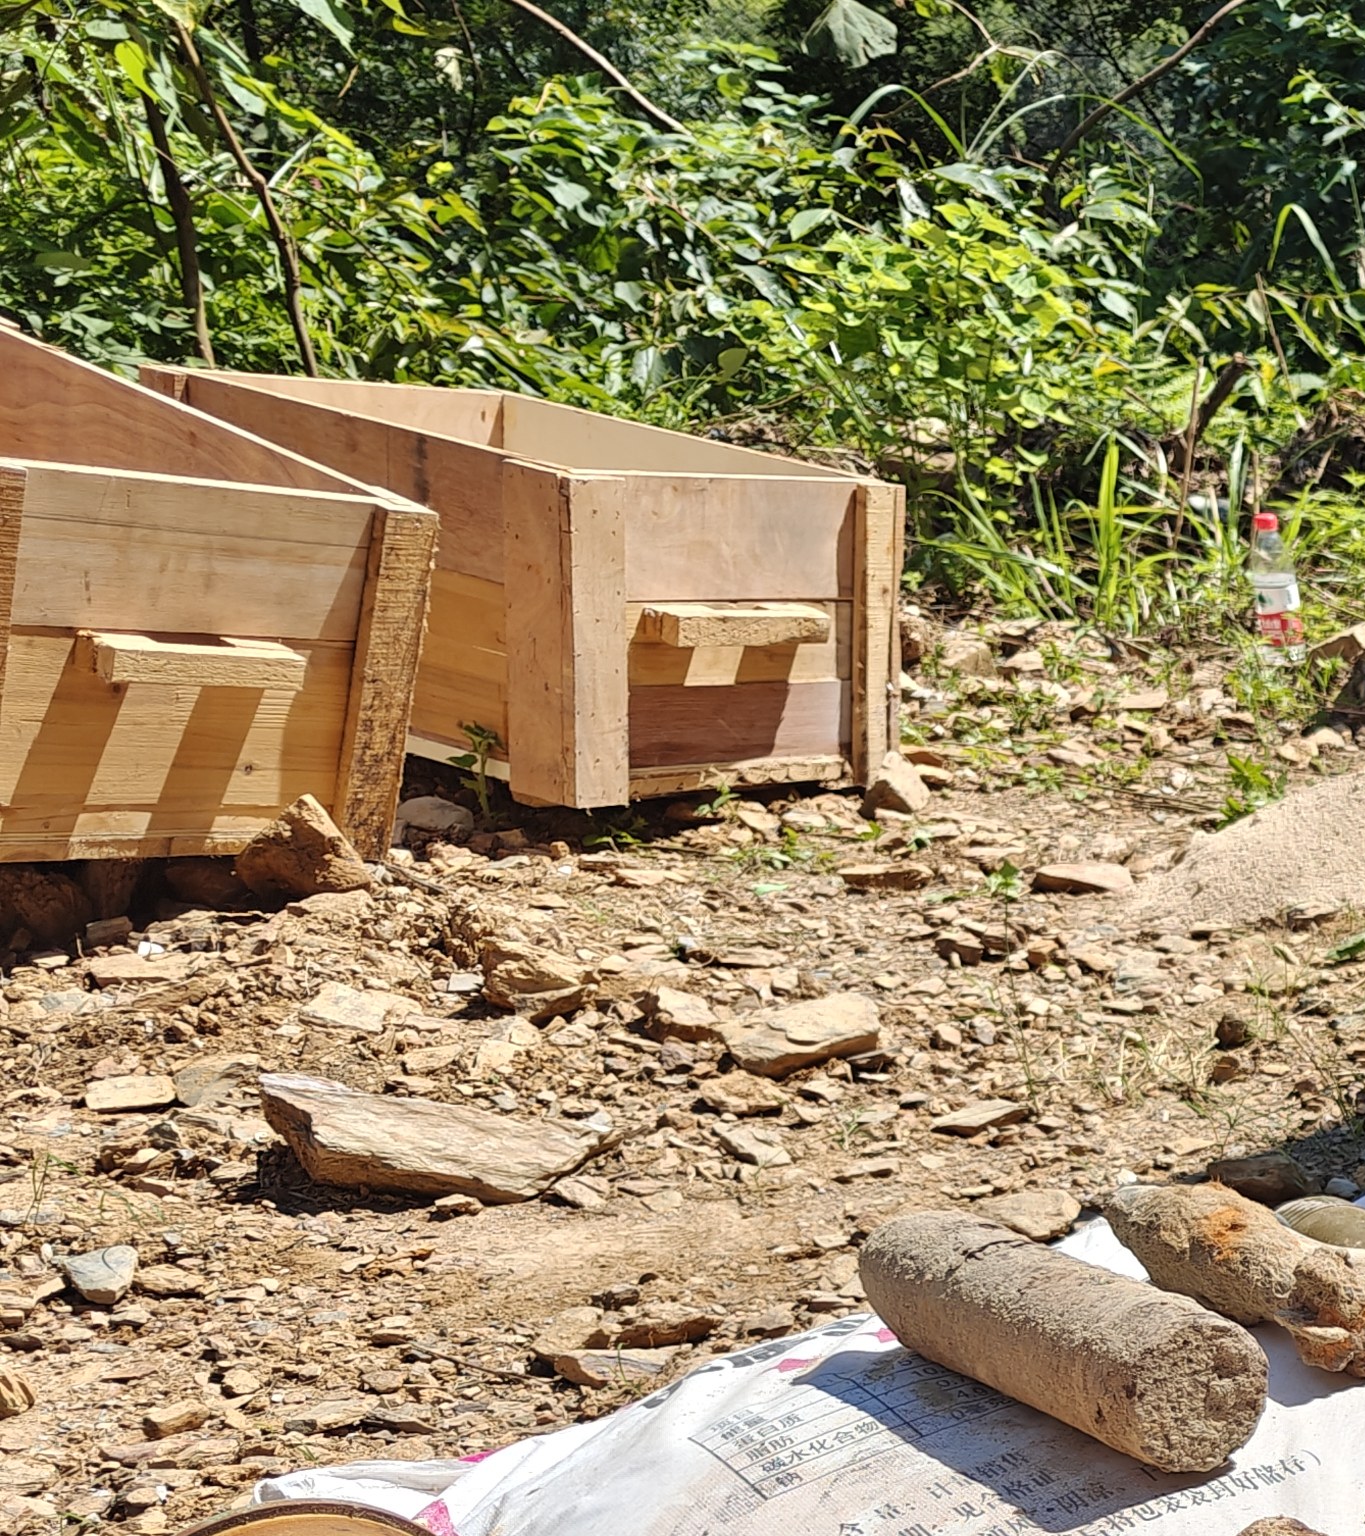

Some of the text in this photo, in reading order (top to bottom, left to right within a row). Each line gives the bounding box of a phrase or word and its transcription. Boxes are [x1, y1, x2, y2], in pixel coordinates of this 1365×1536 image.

[760, 1419, 880, 1473] 碳水化合物
